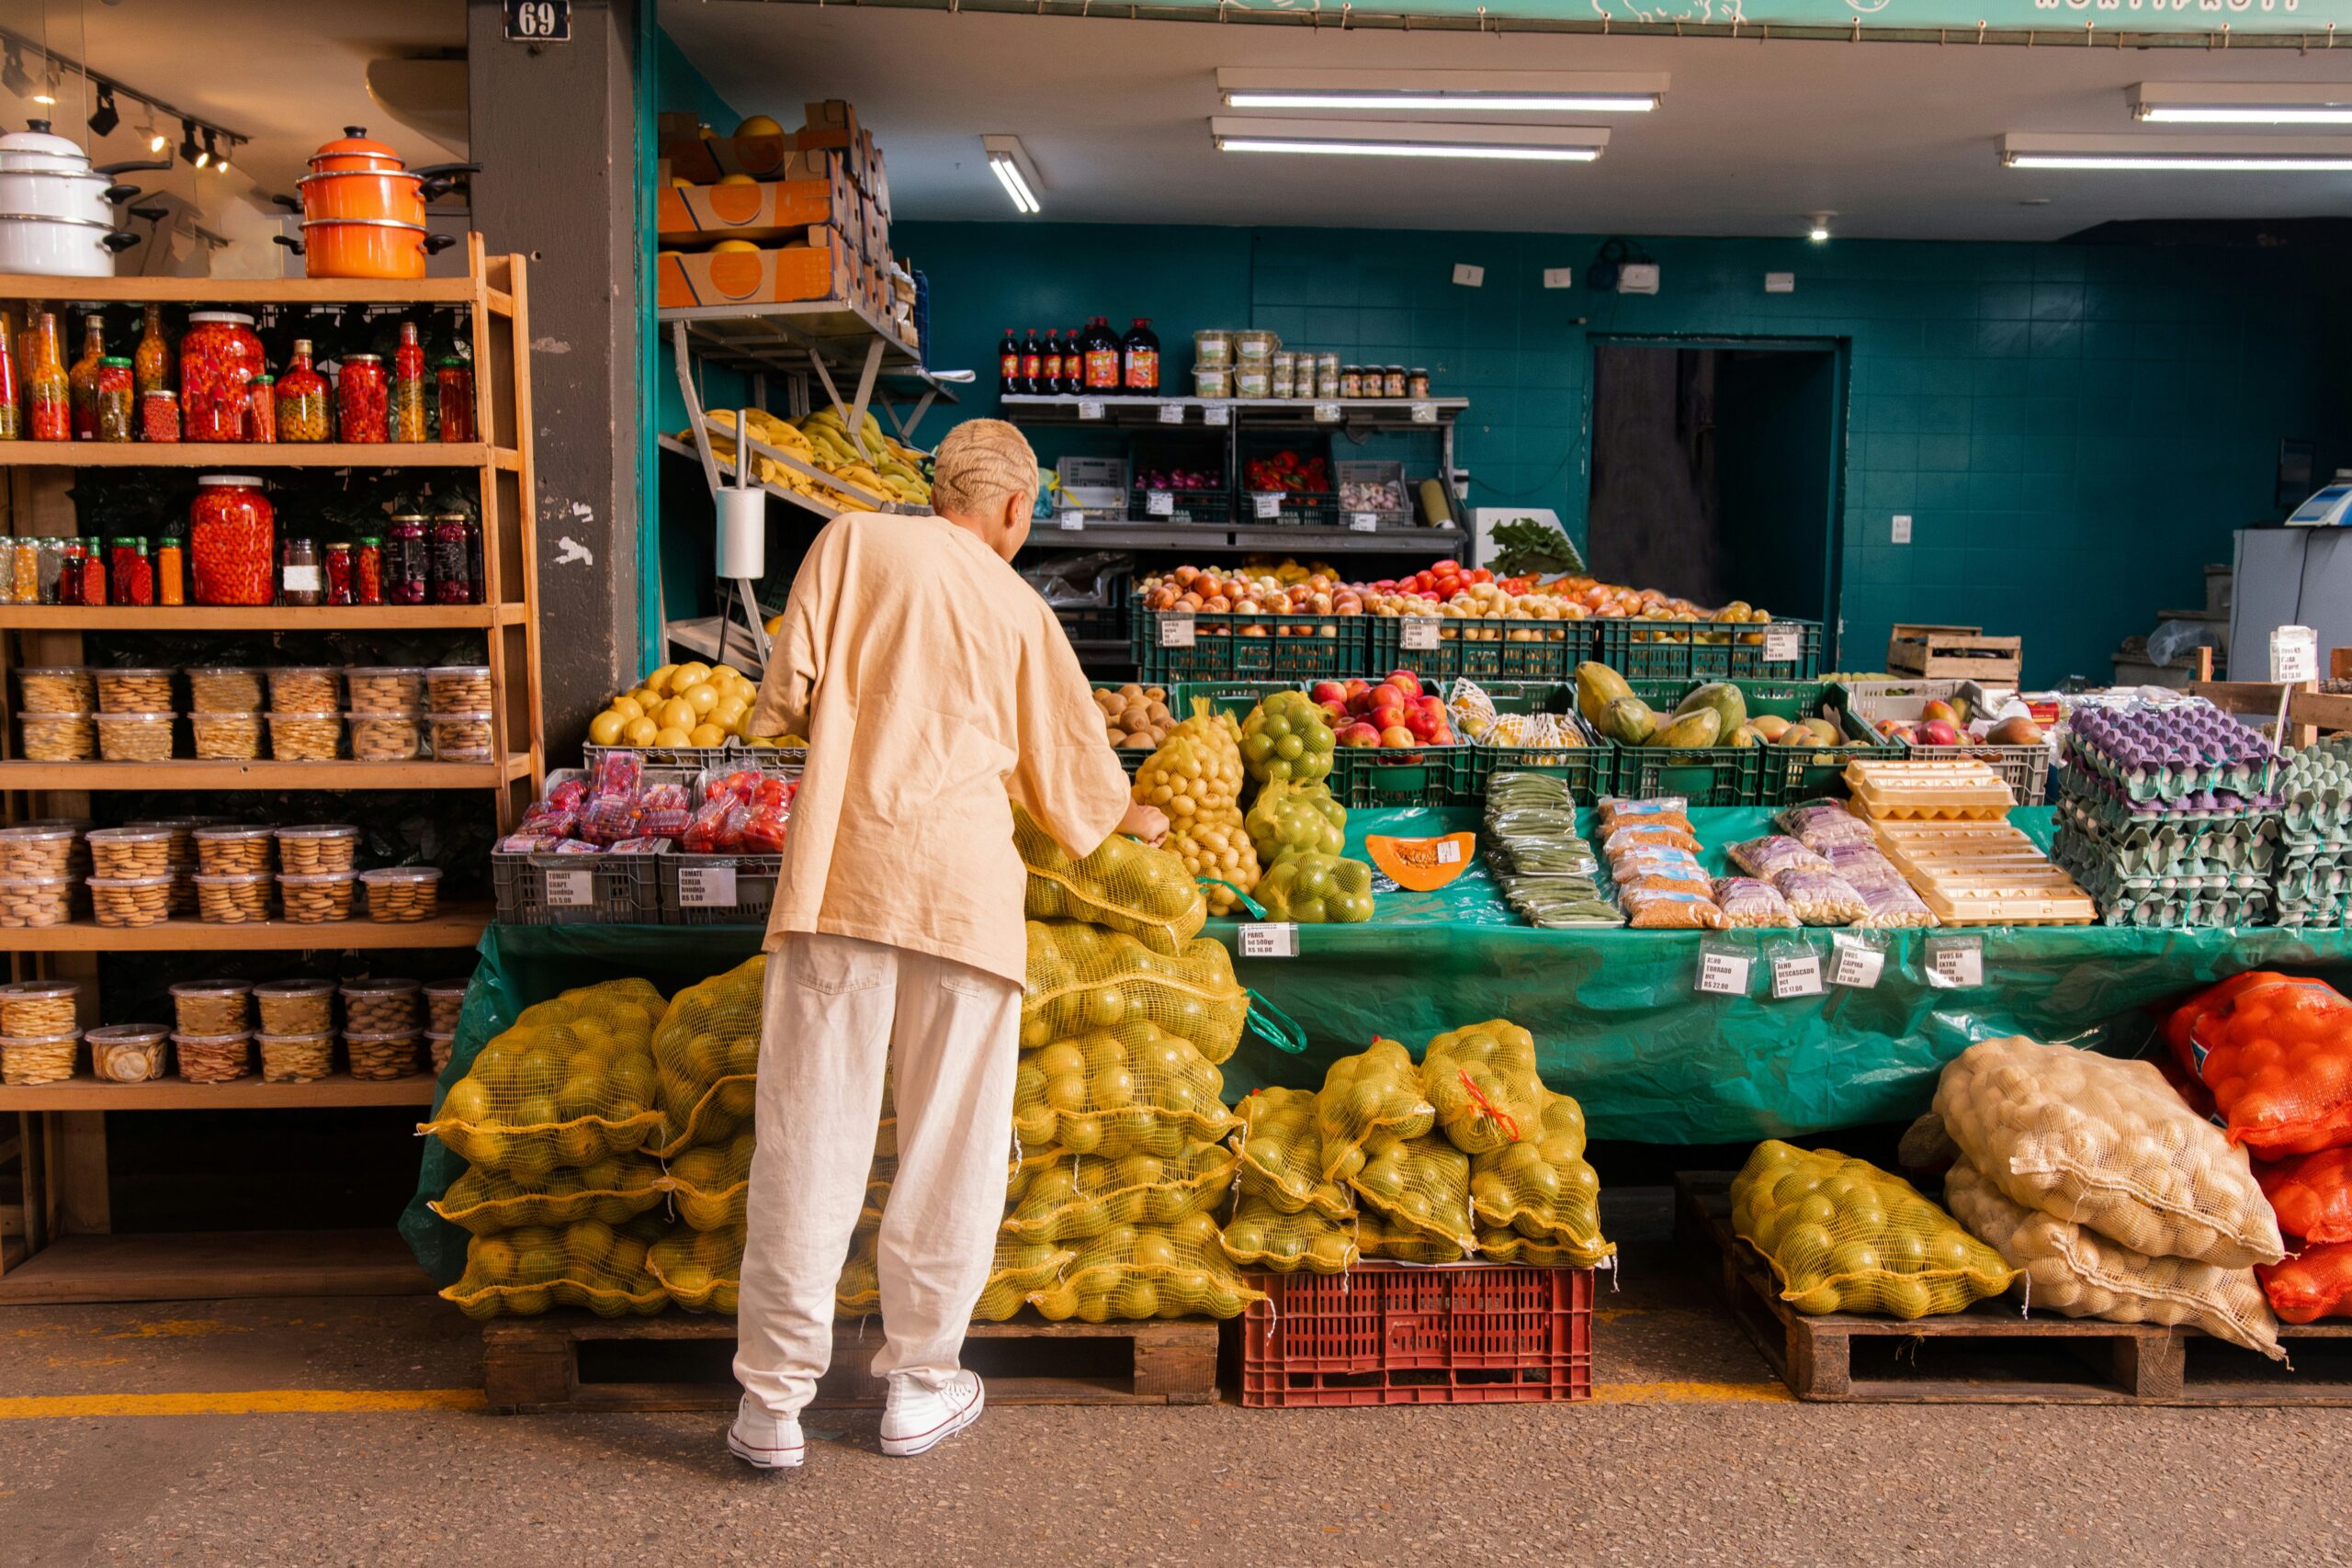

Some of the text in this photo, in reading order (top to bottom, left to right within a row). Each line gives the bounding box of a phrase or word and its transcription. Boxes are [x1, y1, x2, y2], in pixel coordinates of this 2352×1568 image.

[519, 2, 555, 35] 69
[1706, 965, 1732, 974] TORRADO
[1779, 968, 1815, 977] DESCASCADO
